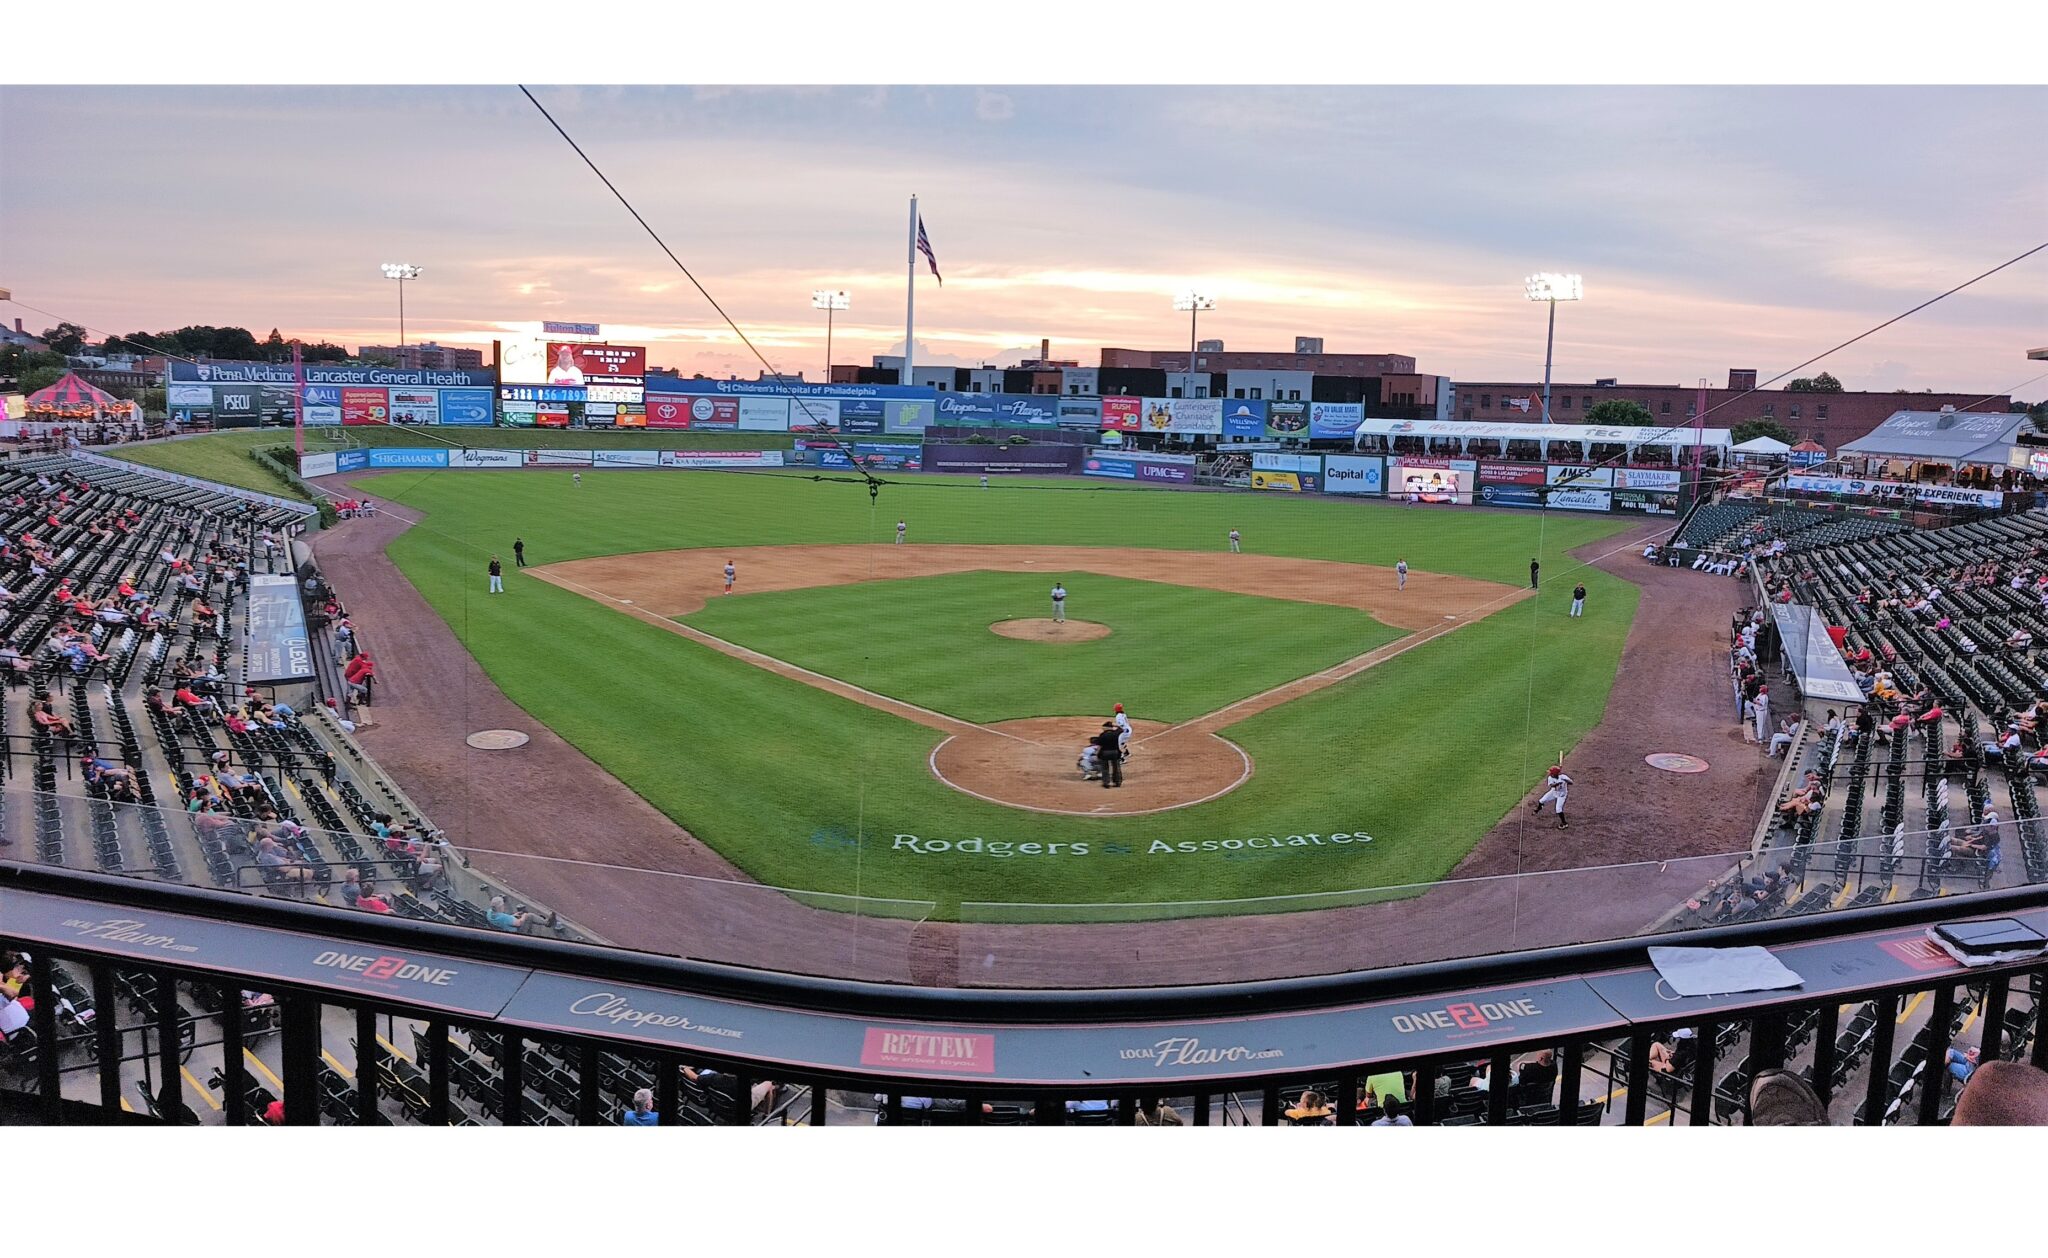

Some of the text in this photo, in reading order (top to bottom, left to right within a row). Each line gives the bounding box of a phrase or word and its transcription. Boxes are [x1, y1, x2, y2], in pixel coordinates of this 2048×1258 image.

[575, 324, 597, 333] Bank
[211, 365, 471, 385] Penn Medicine Lancaster General Health
[732, 385, 775, 393] Children's
[811, 386, 822, 394] of
[823, 386, 877, 396] Philadelphia
[223, 394, 252, 410] PSECU
[939, 397, 977, 414] Clipper
[378, 454, 434, 464] HIGHMARK
[464, 450, 508, 466] Wegmans
[1419, 458, 1449, 466] WILLIAMS
[1143, 465, 1170, 477] UPMC
[1327, 467, 1364, 480] Capital
[1627, 471, 1671, 481] SLAYMAKER
[1553, 491, 1597, 507] Lancaster
[1923, 487, 1984, 503] EXPERIENCE
[891, 834, 1090, 858] Rodgers
[1147, 831, 1374, 854] Associates
[569, 992, 744, 1039] Clipper MAGAZINE
[880, 1032, 978, 1059] RETTEW
[1119, 1048, 1156, 1060] LOCAL
